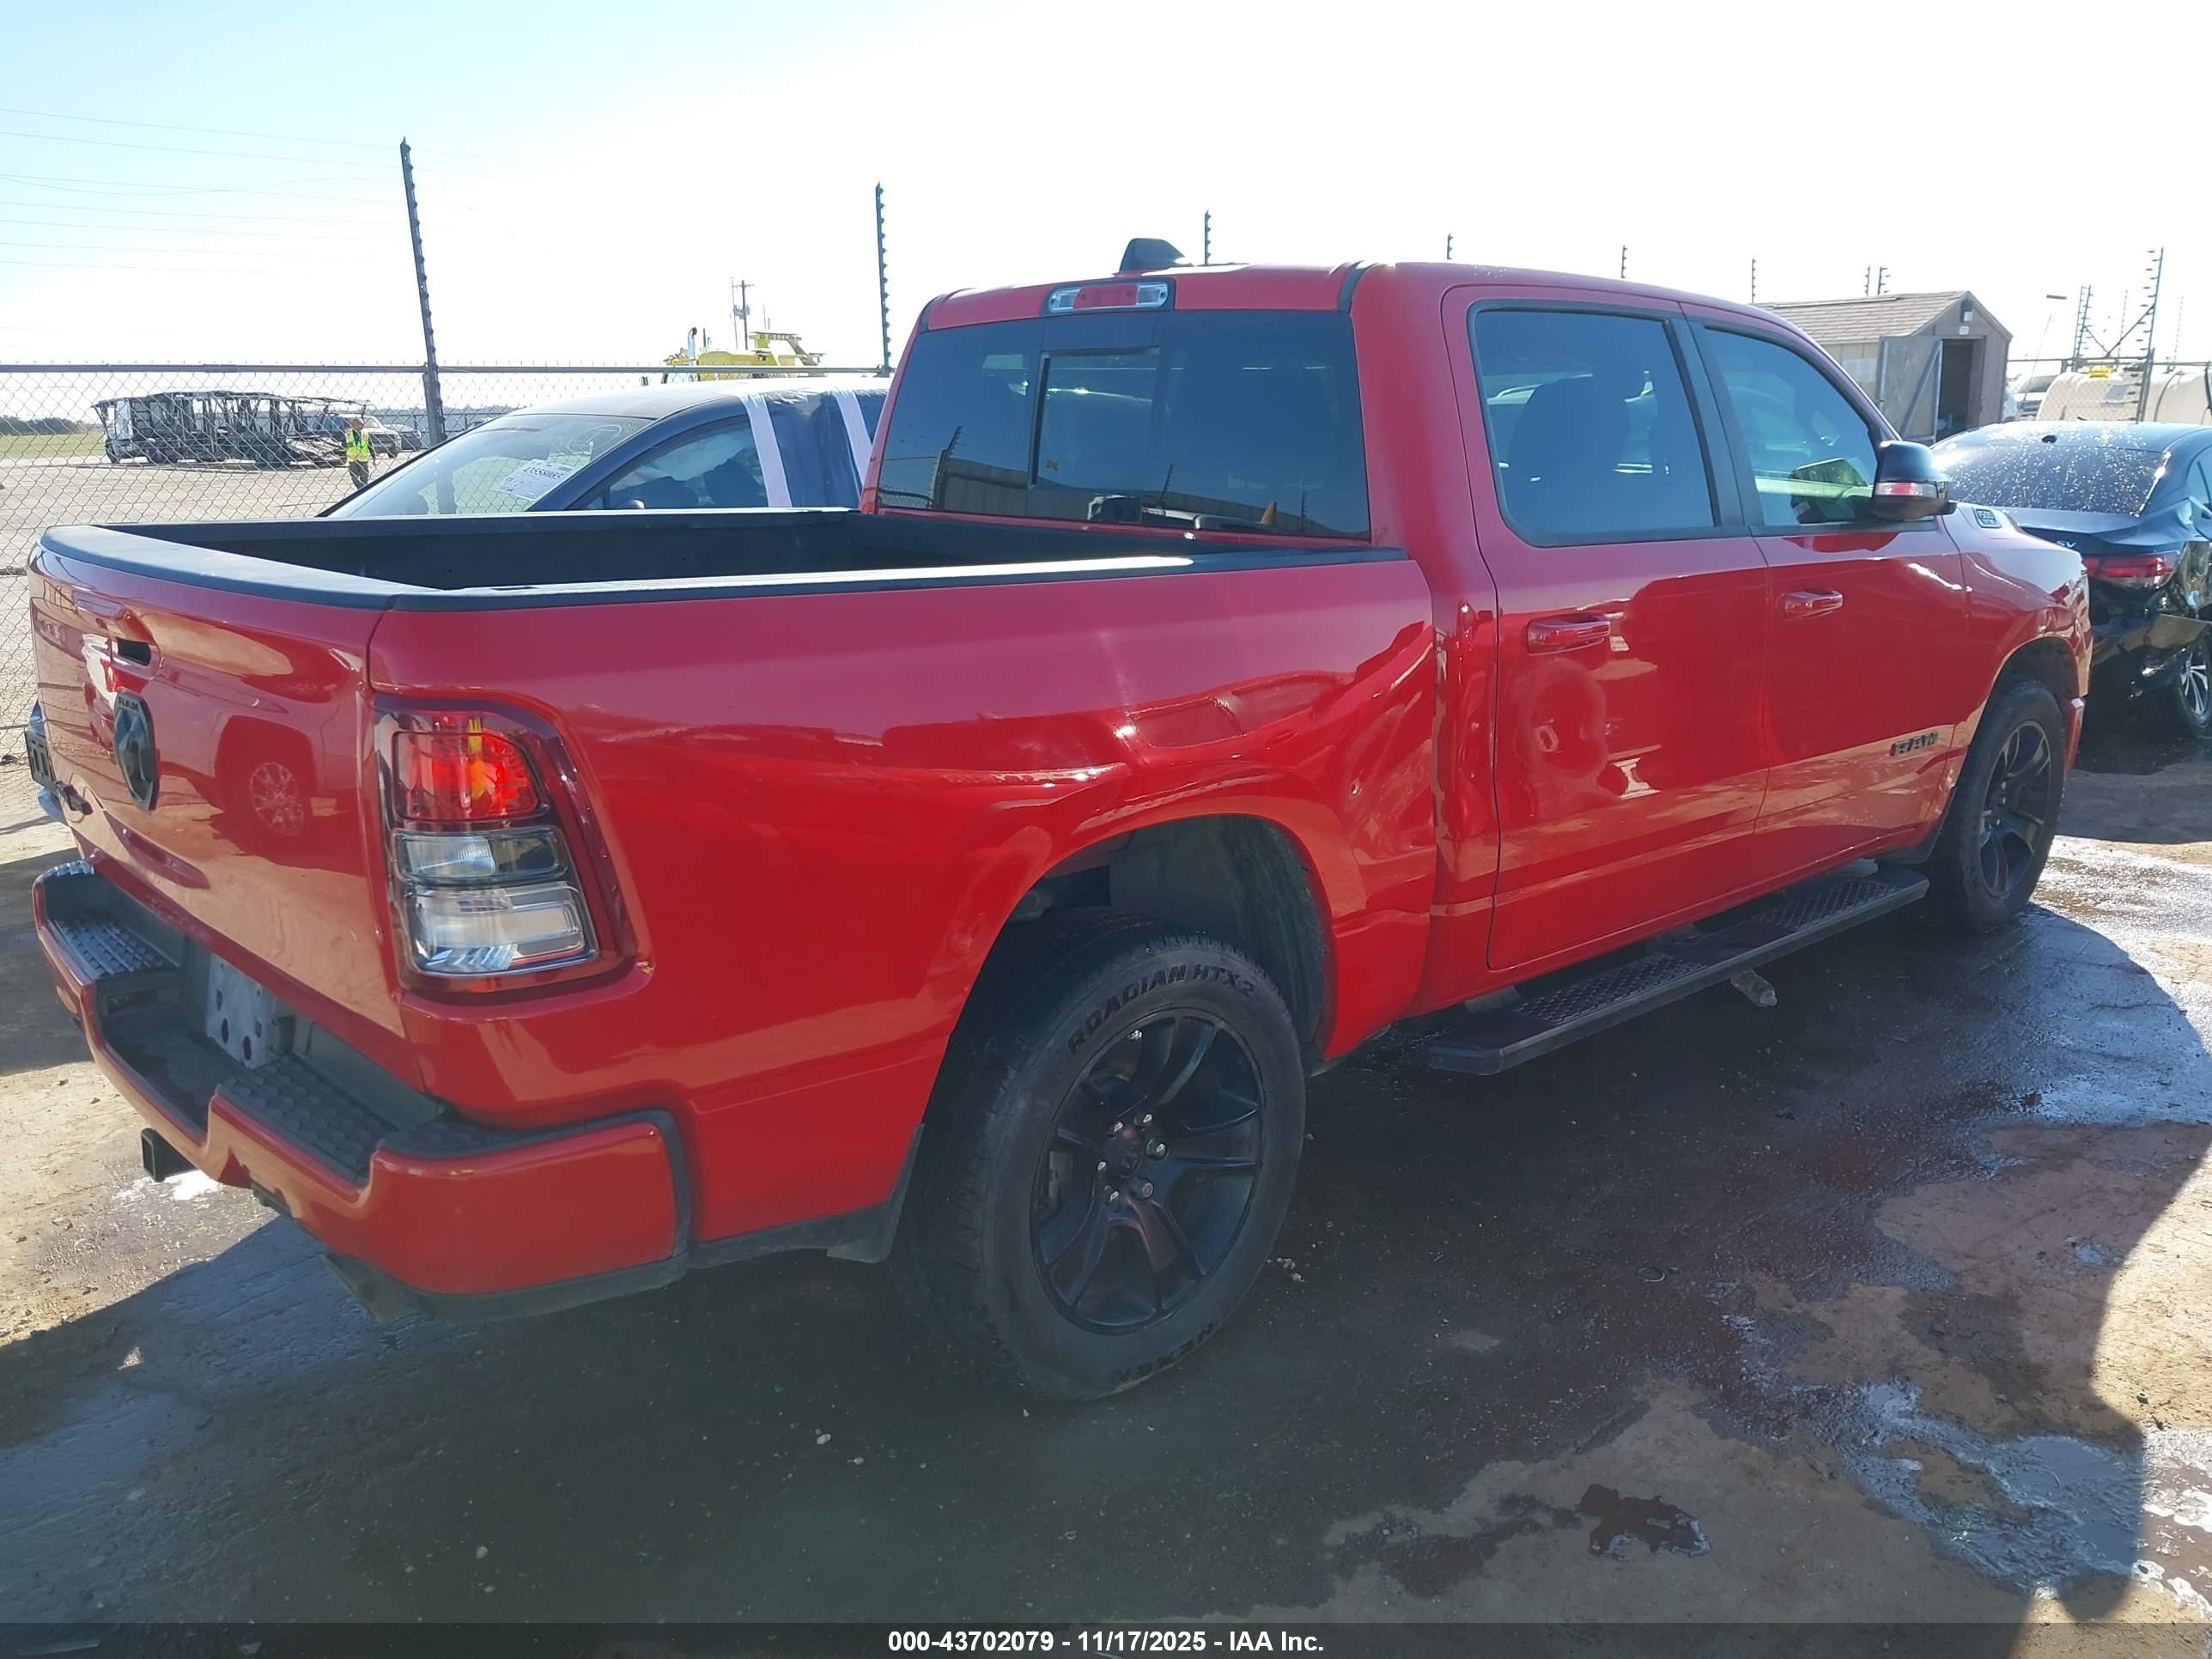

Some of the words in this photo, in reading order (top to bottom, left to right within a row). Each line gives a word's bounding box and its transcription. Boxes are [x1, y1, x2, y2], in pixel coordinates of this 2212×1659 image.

[118, 696, 139, 711] RAM
[1890, 731, 1938, 756] RAM
[1067, 964, 1188, 1053] ROADIAN
[1192, 963, 1255, 997] HTX2
